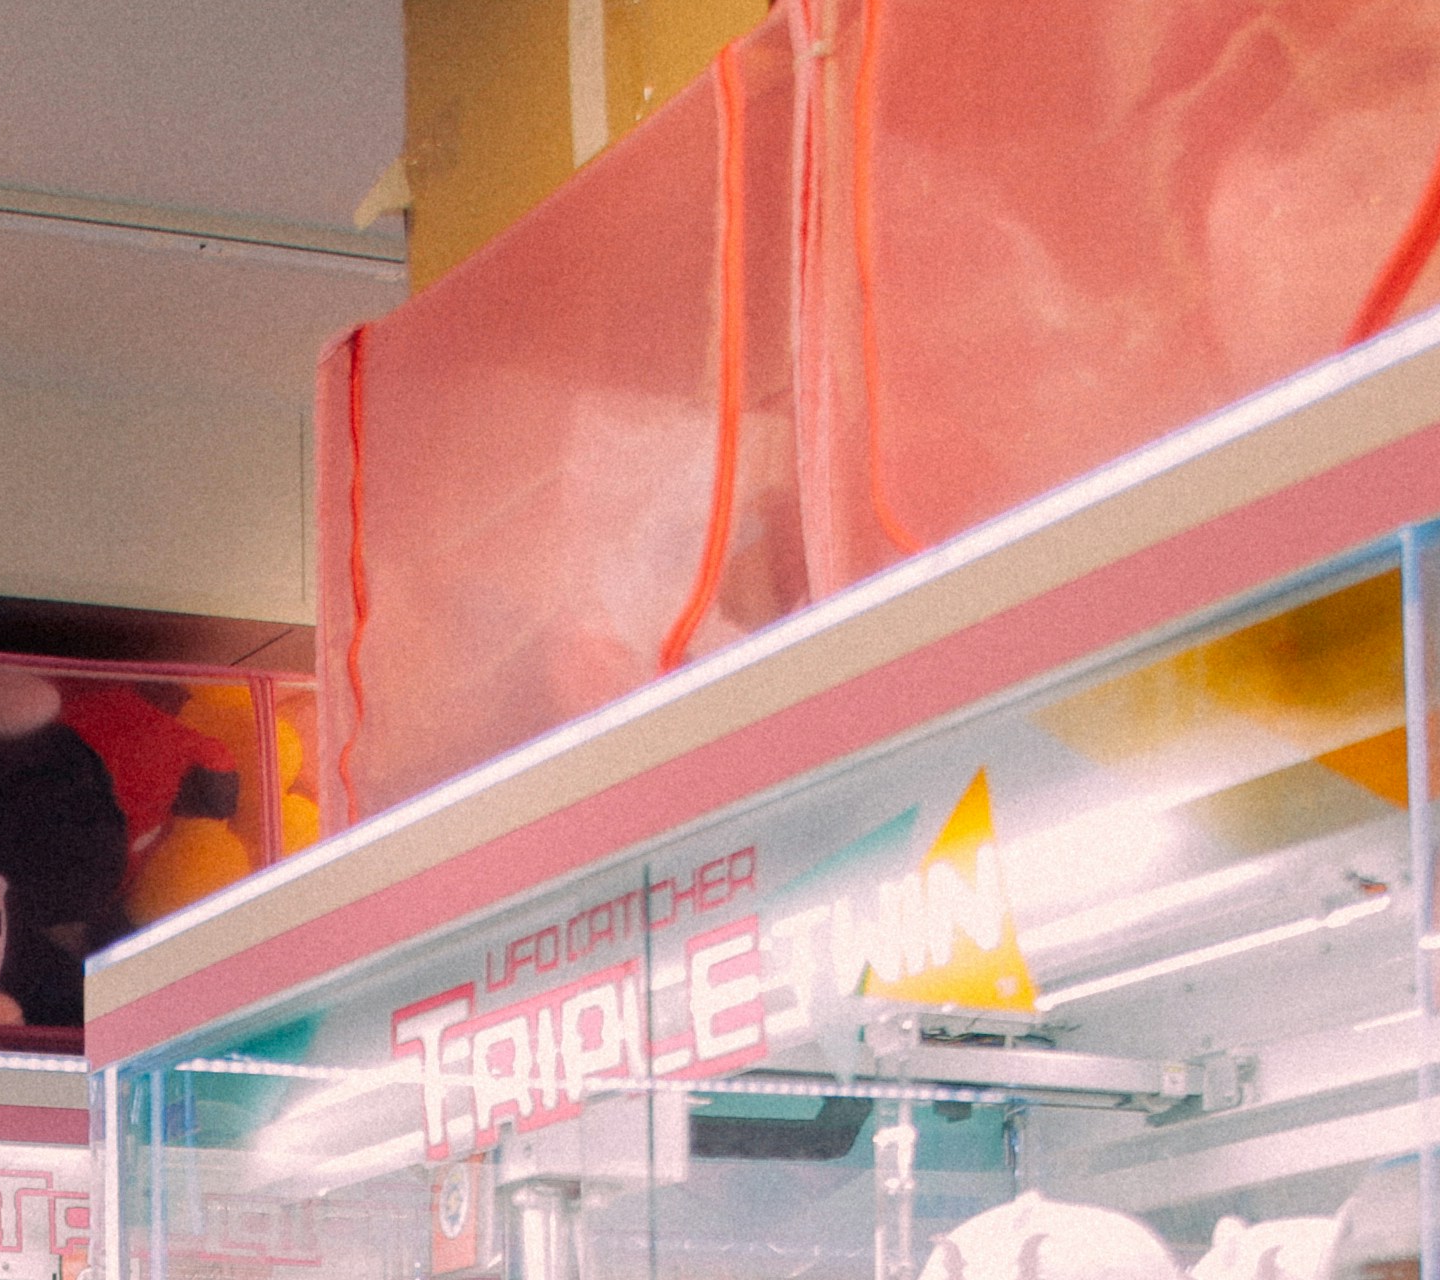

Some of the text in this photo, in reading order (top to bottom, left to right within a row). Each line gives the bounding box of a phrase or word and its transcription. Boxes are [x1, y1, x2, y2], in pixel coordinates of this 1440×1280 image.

[485, 845, 759, 994] UFO CATCHER
[391, 914, 769, 1162] TRIPLE
